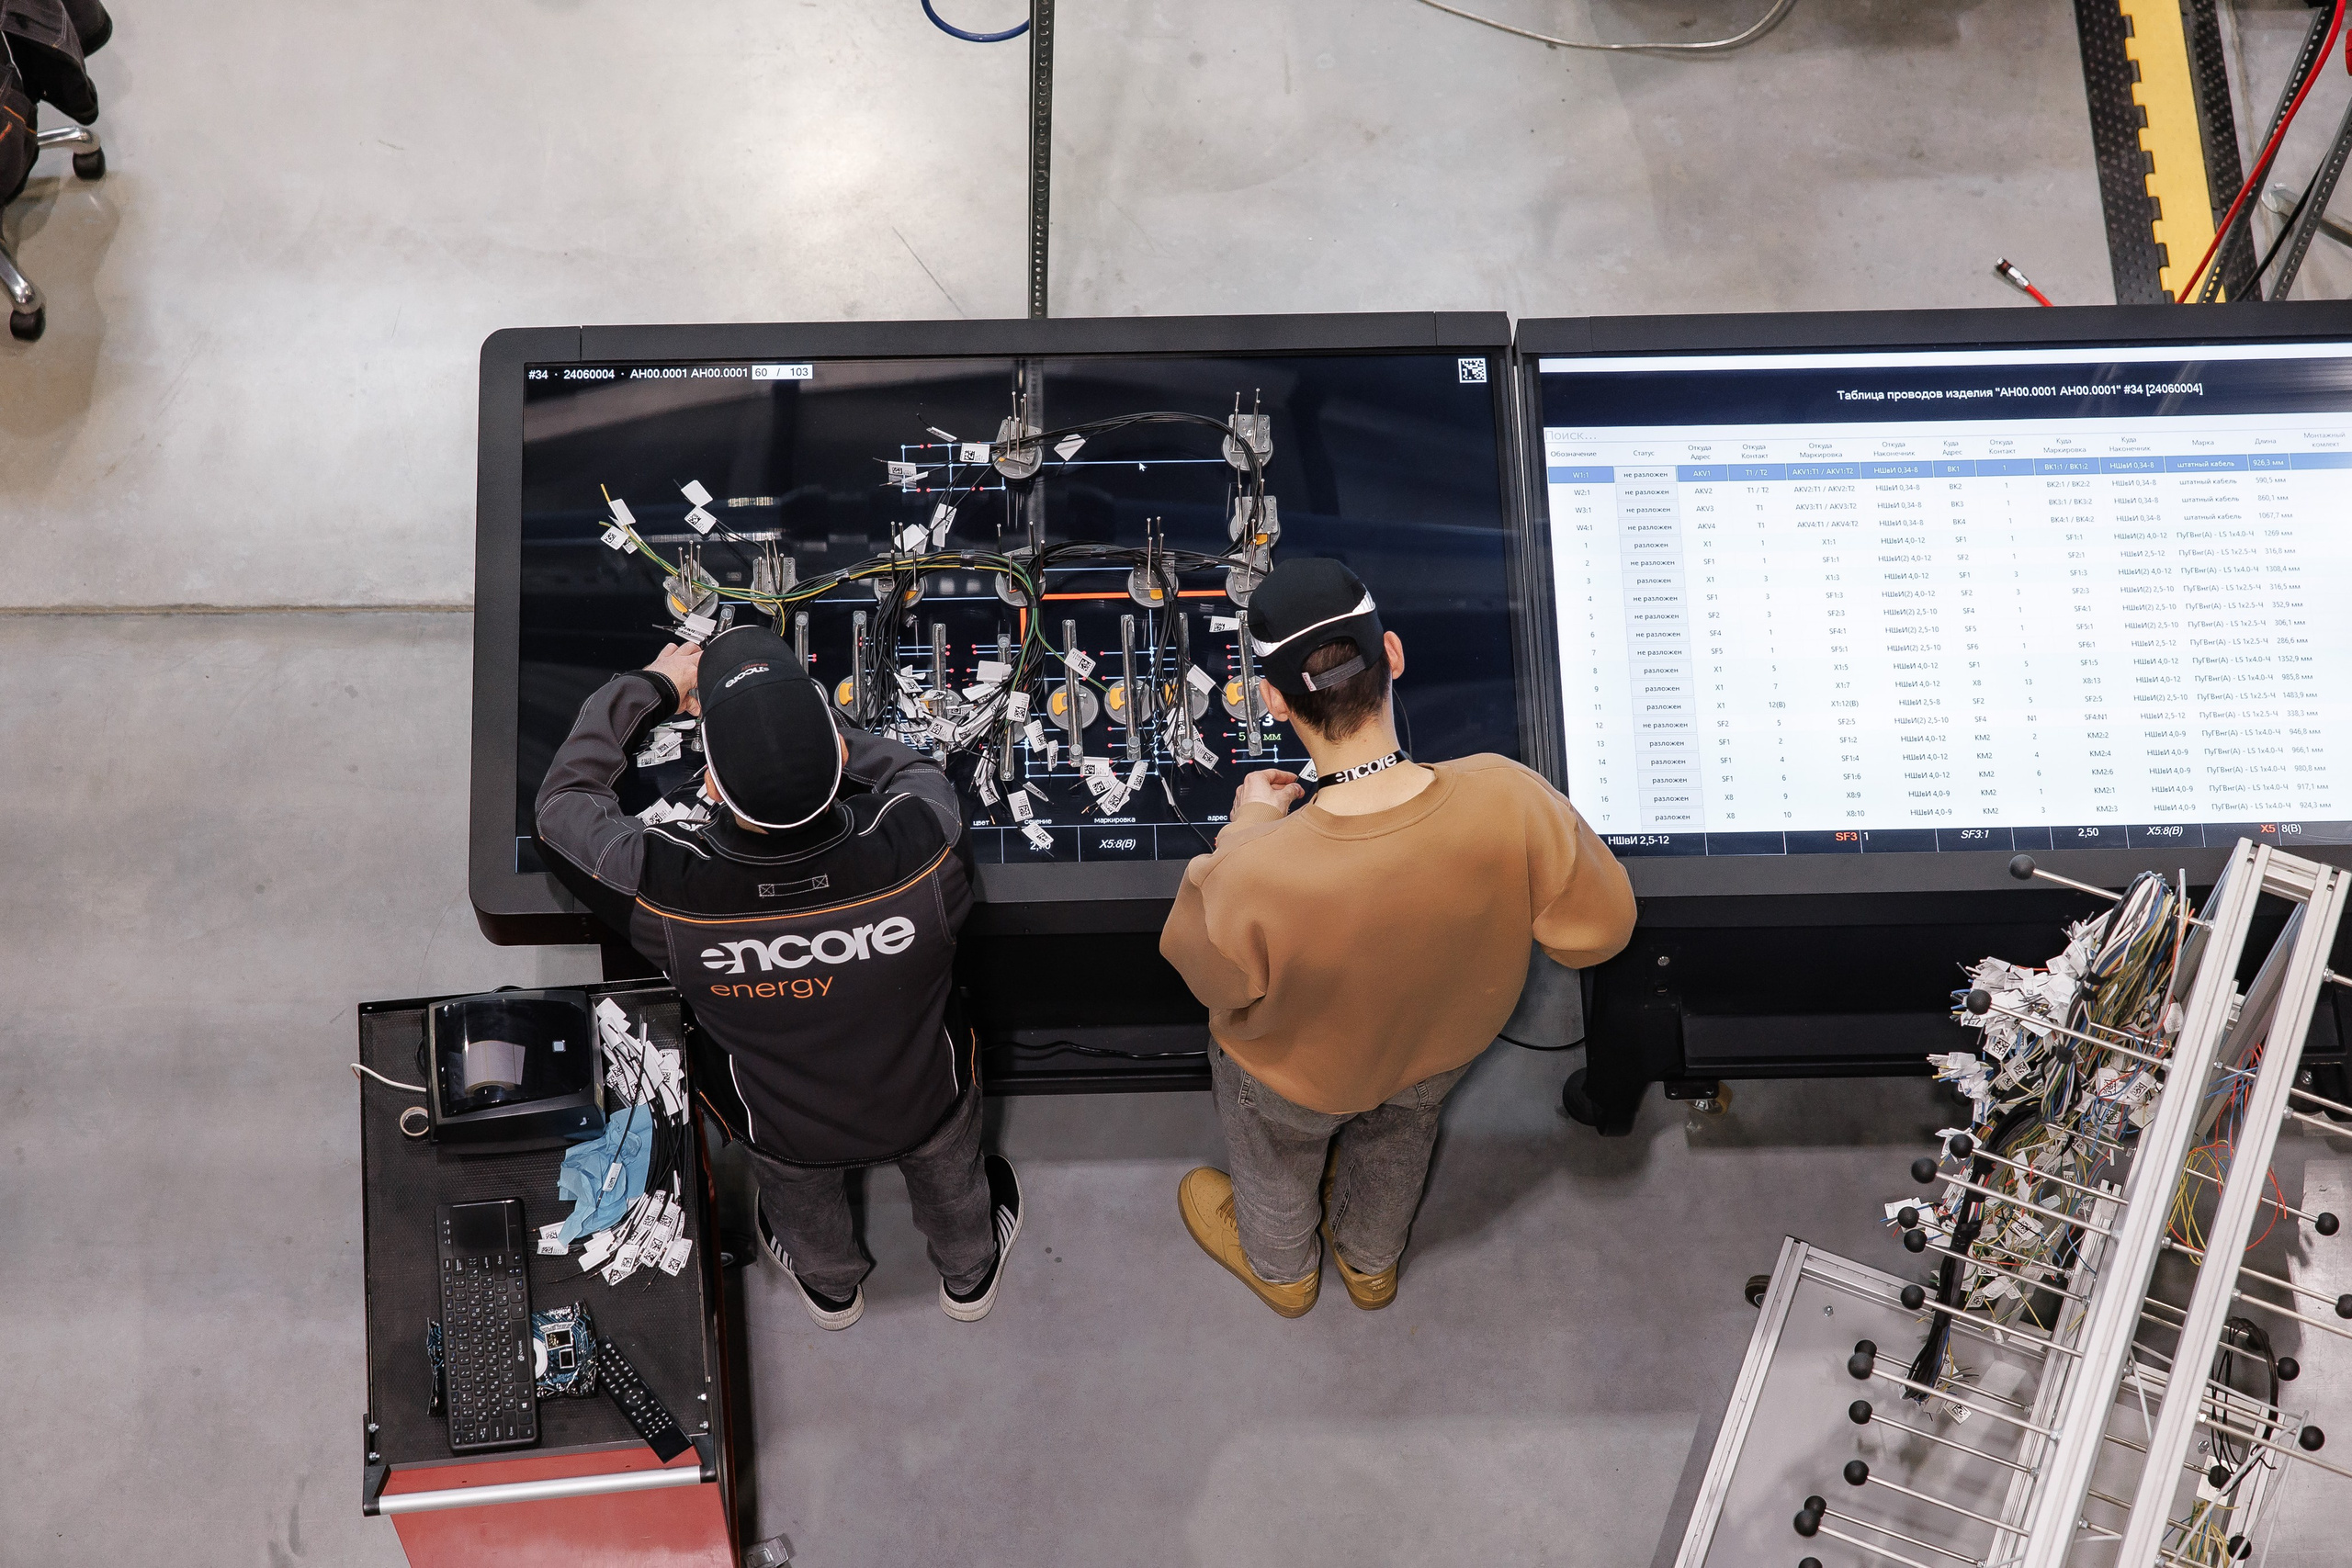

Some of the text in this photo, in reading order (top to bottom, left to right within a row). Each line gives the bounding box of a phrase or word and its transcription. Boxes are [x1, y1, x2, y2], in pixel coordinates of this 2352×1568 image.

[528, 369, 548, 379] #34
[563, 369, 615, 379] 24060004
[755, 367, 768, 377] 60
[789, 367, 808, 377] 103
[1837, 389, 1884, 400] Таблица
[1887, 391, 1943, 401] проводов
[1946, 390, 1993, 400] изделия
[2124, 385, 2143, 394] #34
[2146, 383, 2203, 396] [24060004]
[1335, 753, 1396, 783] encore
[1961, 829, 1989, 839] SF3:1
[2078, 828, 2098, 838] 2,50
[2147, 826, 2183, 837] X5:8(B)
[2281, 824, 2301, 834] 8(B)
[1608, 836, 1669, 846] НШвИ 2,5-12
[1836, 832, 1857, 840] SF3
[1863, 831, 1869, 841] 1
[1099, 839, 1136, 851] X5:8(B)
[700, 916, 916, 975] encore
[710, 976, 833, 998] energy
